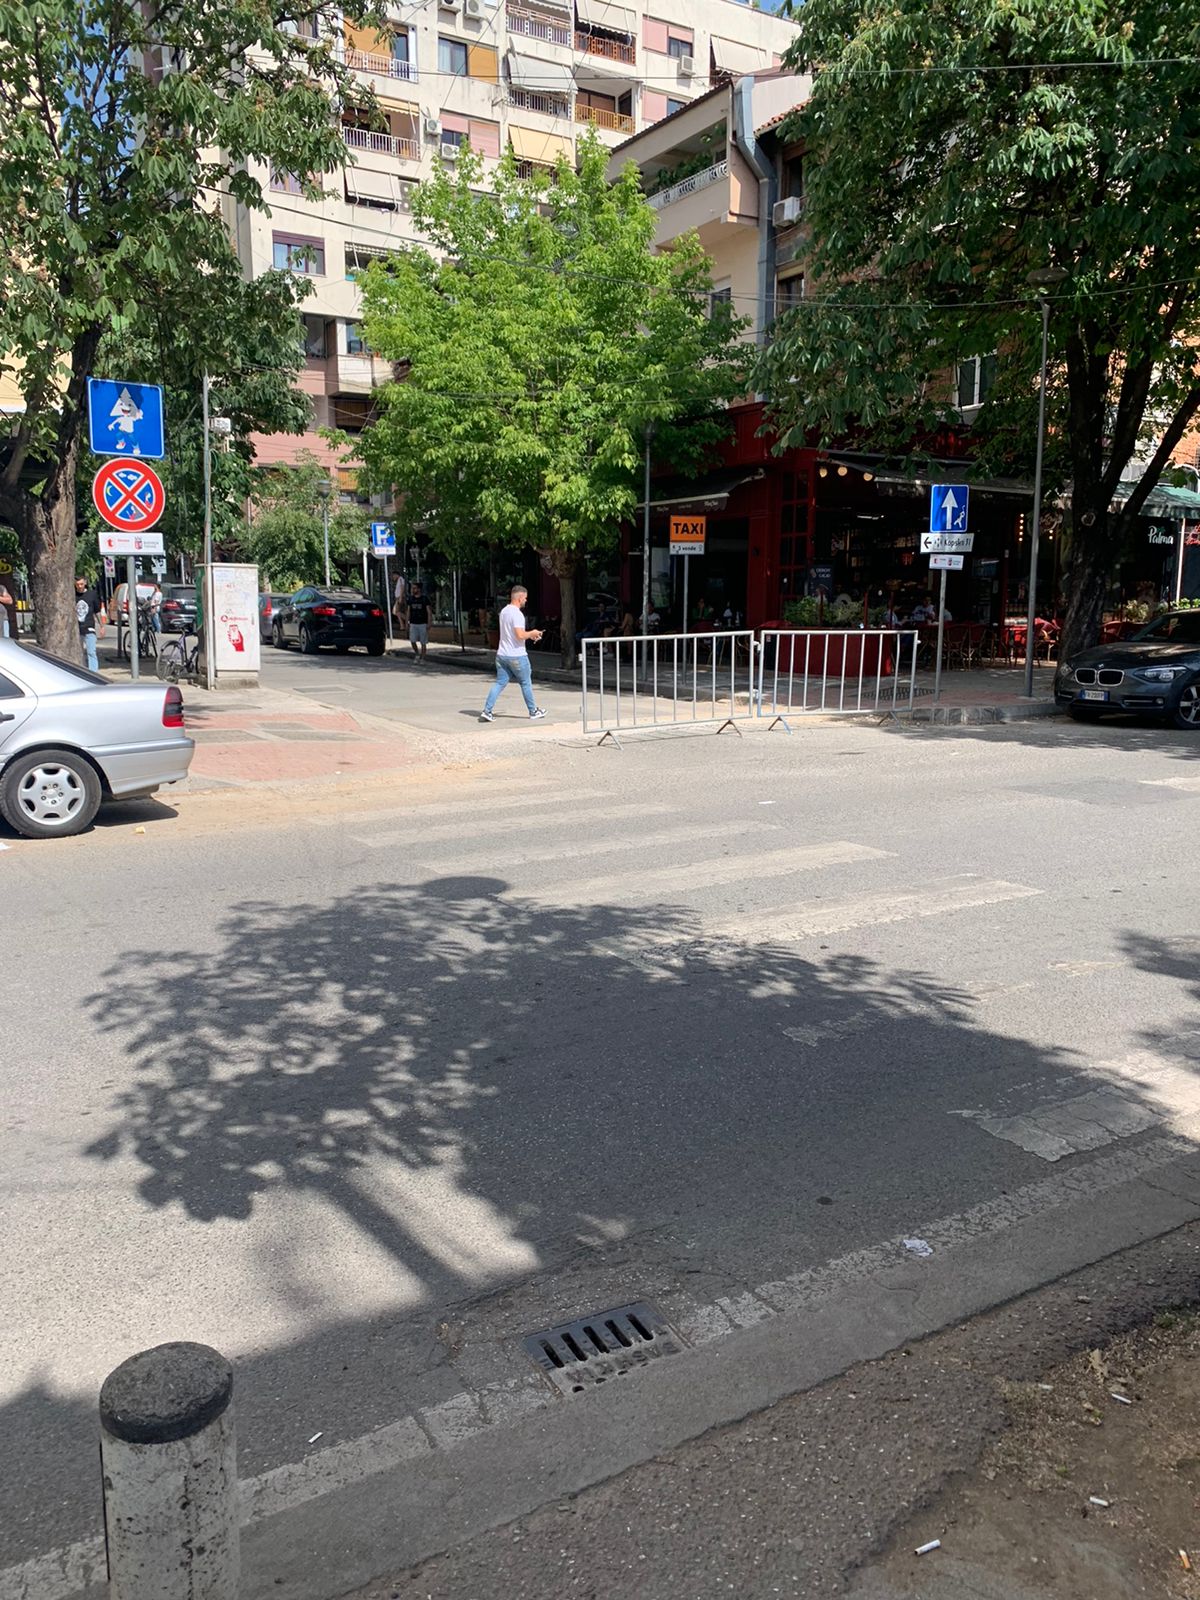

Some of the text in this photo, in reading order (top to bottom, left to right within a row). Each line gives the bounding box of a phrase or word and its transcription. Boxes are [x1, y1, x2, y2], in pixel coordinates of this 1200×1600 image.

[376, 525, 390, 545] P
[673, 522, 703, 535] TAXI
[1148, 525, 1174, 545] Palma
